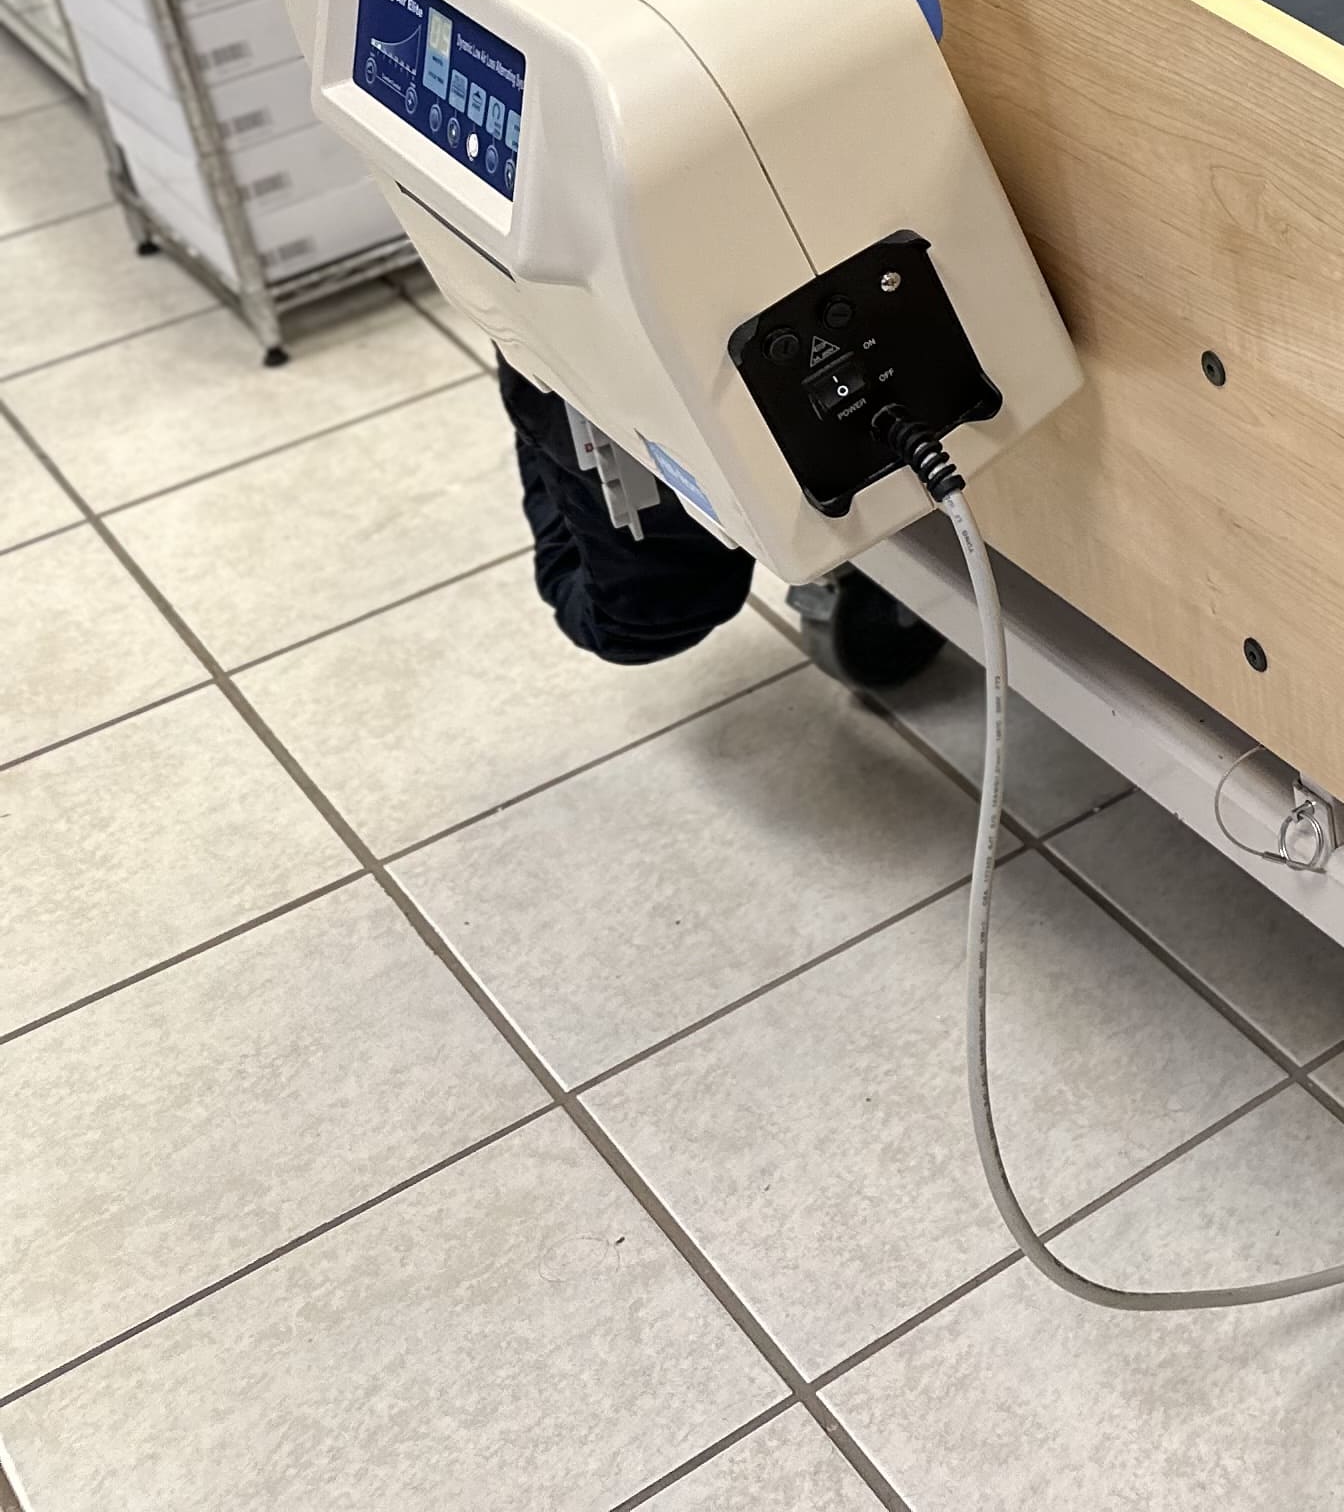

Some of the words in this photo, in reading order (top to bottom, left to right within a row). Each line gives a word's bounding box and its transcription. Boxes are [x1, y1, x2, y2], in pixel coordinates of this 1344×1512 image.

[863, 338, 876, 350] ON
[878, 367, 895, 382] OFF
[837, 398, 867, 421] POWER
